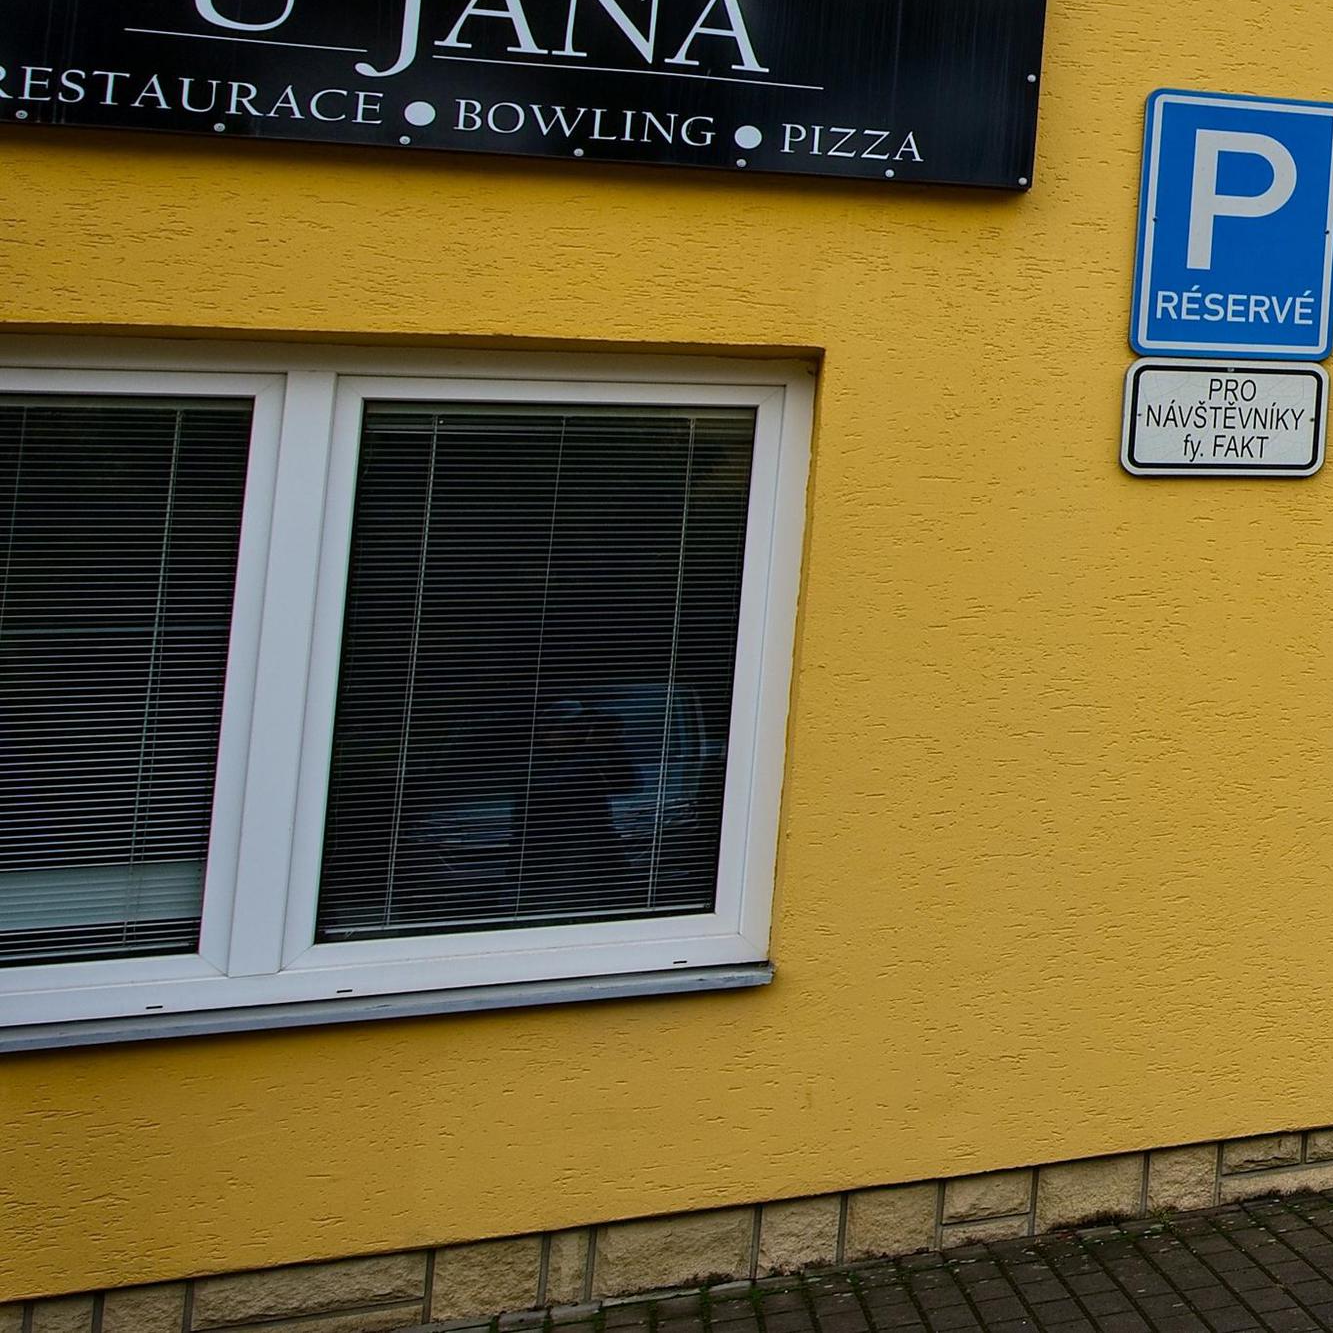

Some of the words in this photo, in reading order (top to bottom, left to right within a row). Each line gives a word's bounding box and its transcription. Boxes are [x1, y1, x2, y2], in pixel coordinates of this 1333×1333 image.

[452, 98, 717, 148] BOWLING
[780, 122, 925, 163] PIZZA
[1186, 128, 1298, 271] P
[1155, 284, 1315, 326] RÉSERVÉ
[1208, 377, 1257, 403] PRO
[1145, 401, 1306, 432] NÁVŠTĚVNÍKY
[1183, 434, 1204, 463] fy.
[1212, 434, 1270, 459] FAKT
